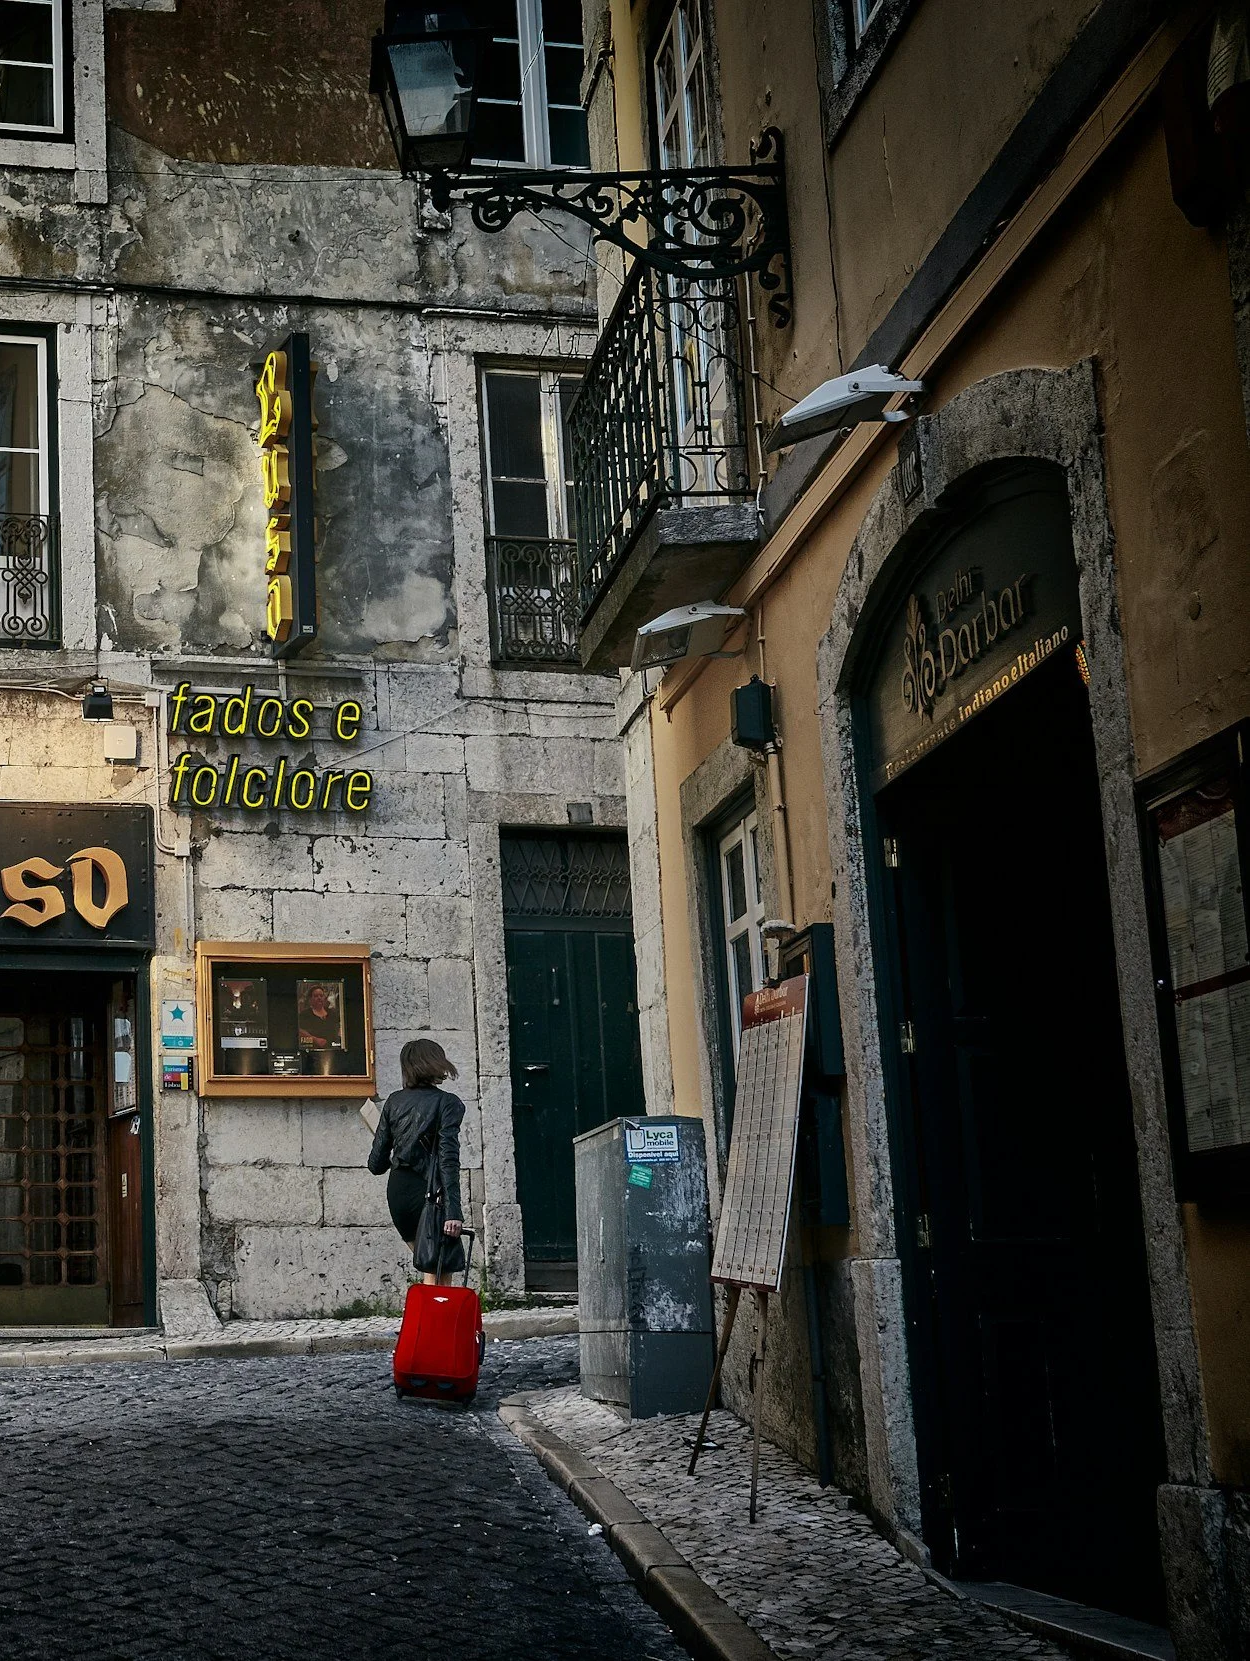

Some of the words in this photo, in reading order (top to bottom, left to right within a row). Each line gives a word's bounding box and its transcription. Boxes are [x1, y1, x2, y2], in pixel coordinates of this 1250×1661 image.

[935, 568, 974, 624] Delhi
[938, 573, 1029, 681] Darbar
[957, 673, 1010, 722] Indiano
[1016, 624, 1069, 677] Italiano
[170, 682, 315, 738] fados
[336, 701, 361, 741] e
[173, 753, 371, 811] folclore
[646, 1130, 674, 1140] Lyca
[663, 1150, 679, 1158] aqui
